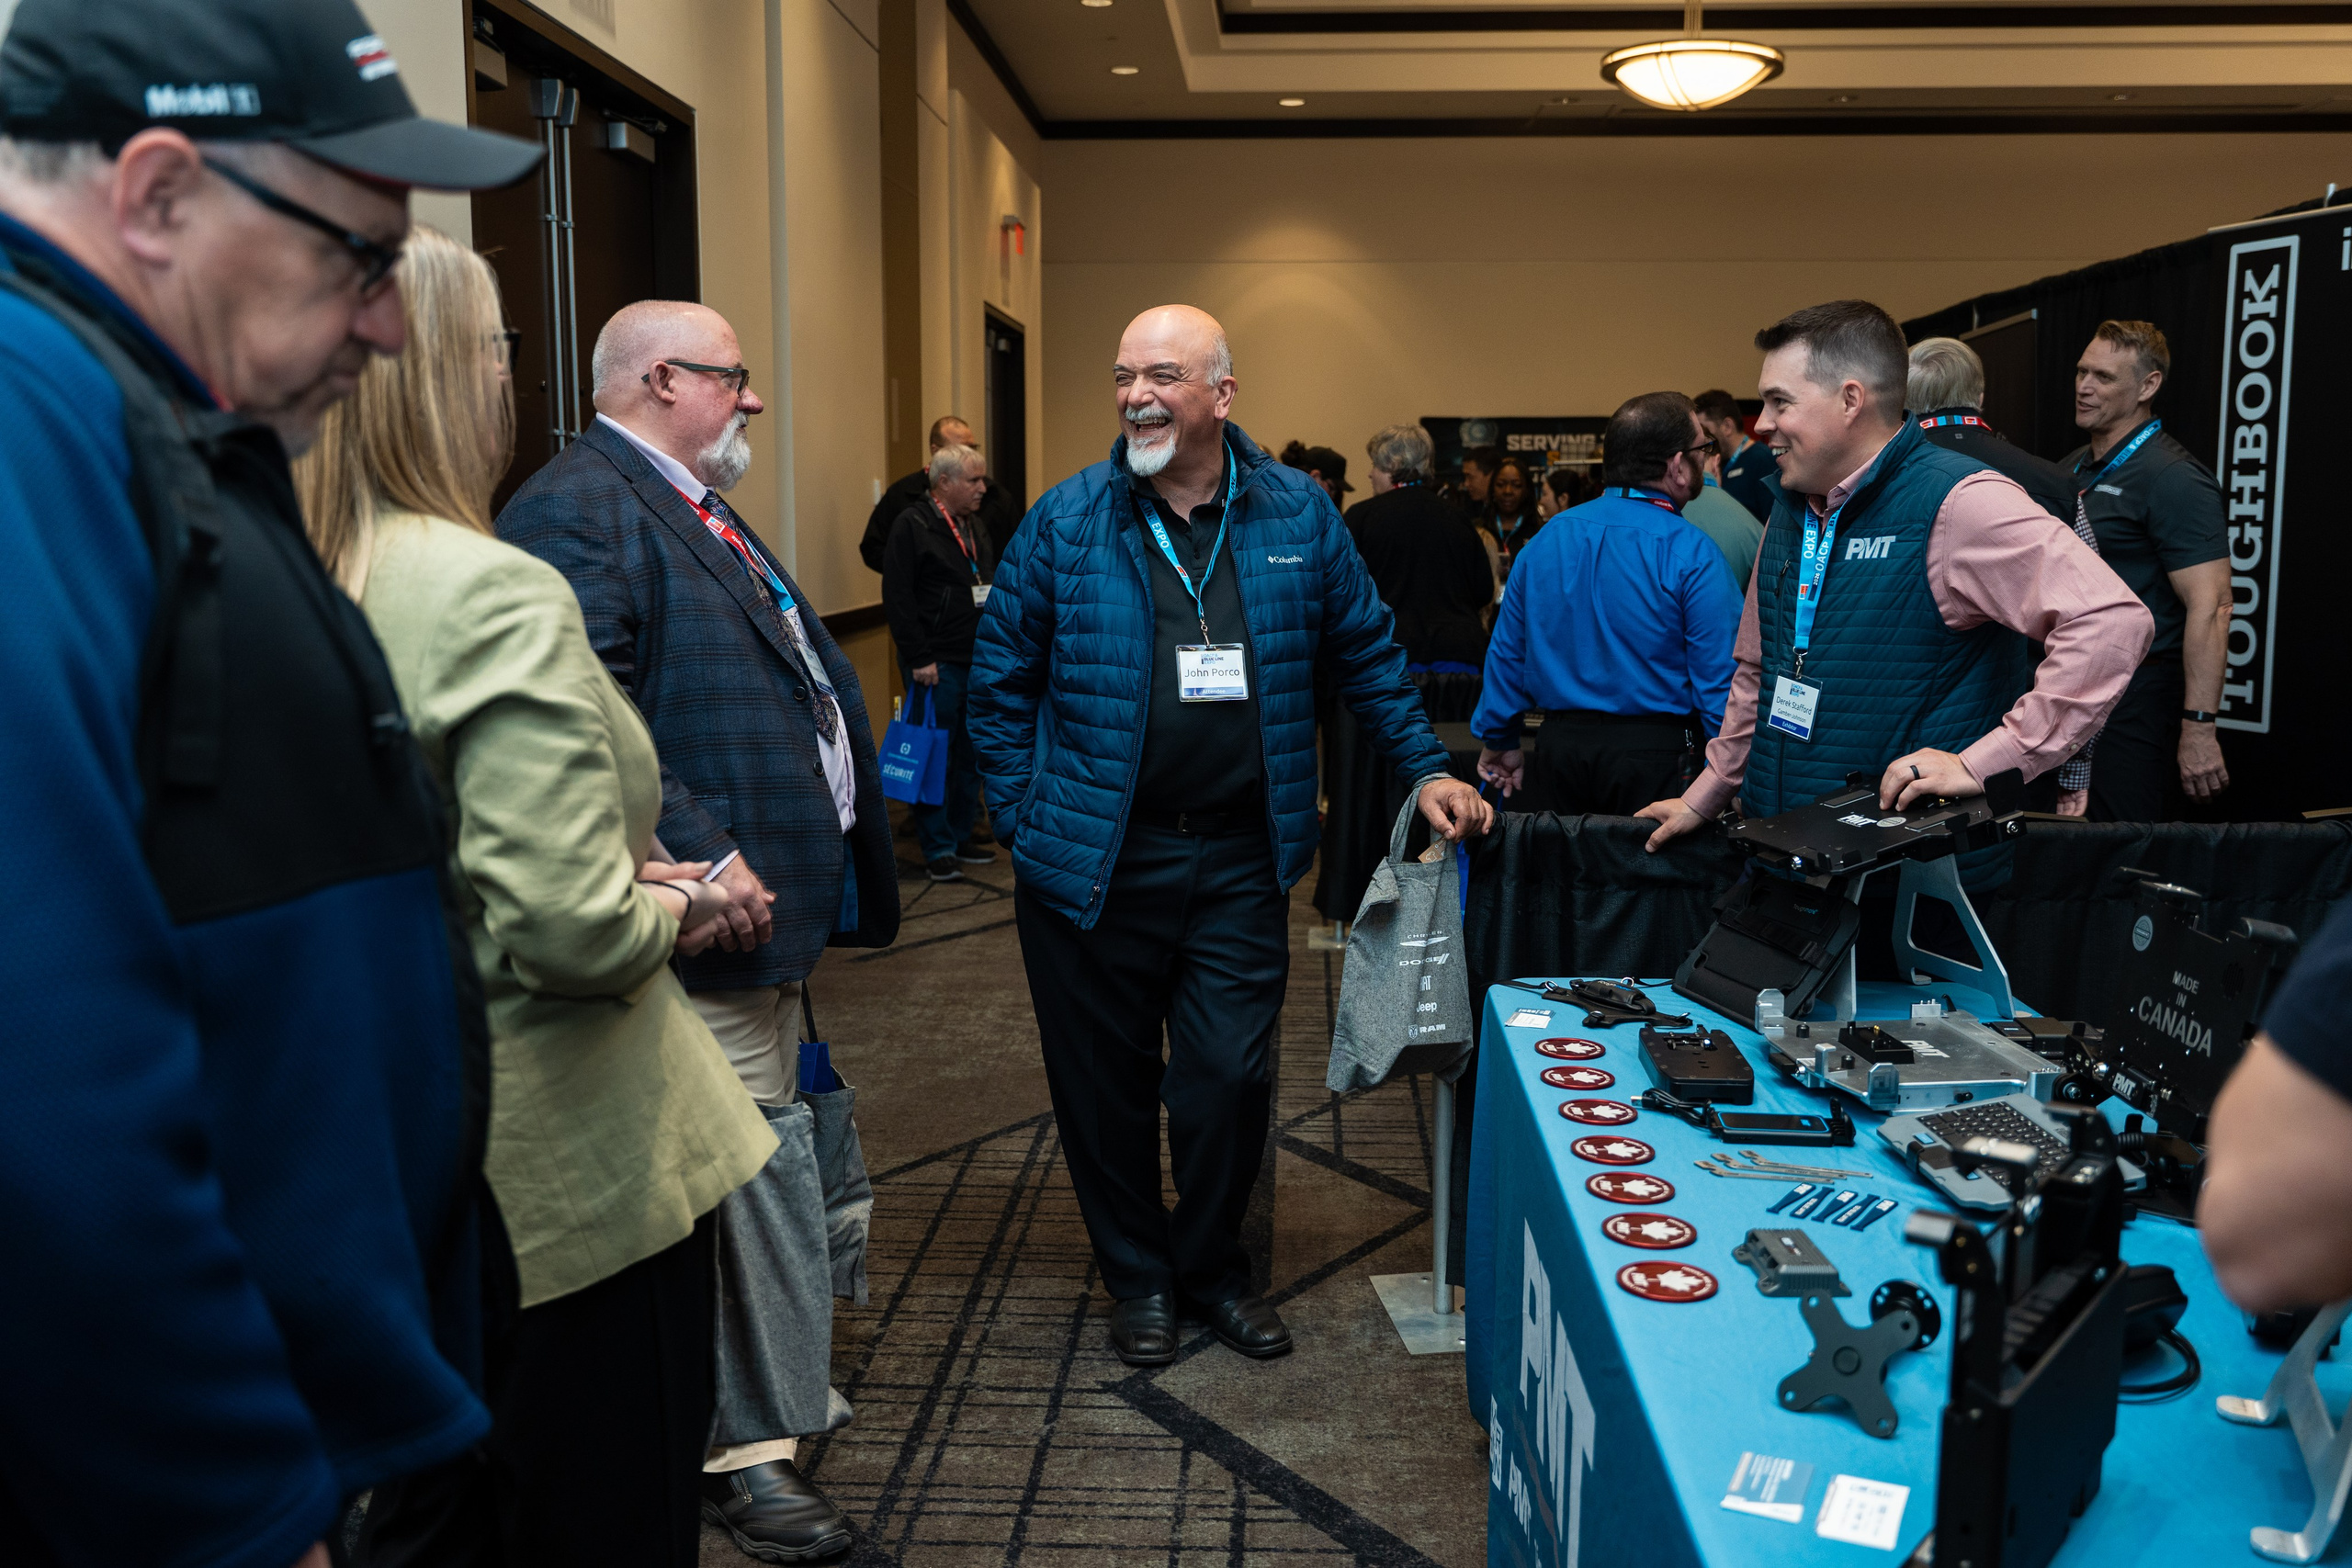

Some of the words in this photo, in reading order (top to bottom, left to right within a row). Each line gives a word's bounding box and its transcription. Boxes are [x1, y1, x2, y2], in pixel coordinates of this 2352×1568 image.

[145, 83, 230, 117] Mobil
[2219, 264, 2280, 714] TOUGHBOOK
[1151, 522, 1170, 549] EXPO
[1803, 529, 1816, 559] EXPO
[1826, 530, 1833, 538] &
[1273, 554, 1304, 564] Columbia
[1815, 540, 1830, 572] OACP
[1844, 536, 1896, 560] PMT
[1813, 572, 1821, 586] 2026
[1184, 668, 1209, 678] John
[1212, 668, 1240, 677] Porco
[1776, 695, 1792, 707] Derek
[1792, 701, 1813, 716] Stafford
[1781, 720, 1798, 731] Exhibitor
[1837, 814, 1878, 827] PMT
[2171, 970, 2199, 995] MADE
[1416, 1001, 1438, 1012] Jeep
[2175, 991, 2188, 1008] IN
[1419, 1023, 1446, 1033] RAM
[2137, 995, 2213, 1057] CANADA
[2111, 1072, 2137, 1097] PMT
[1519, 1217, 1597, 1568] PMT
[1508, 1450, 1532, 1547] PMT
